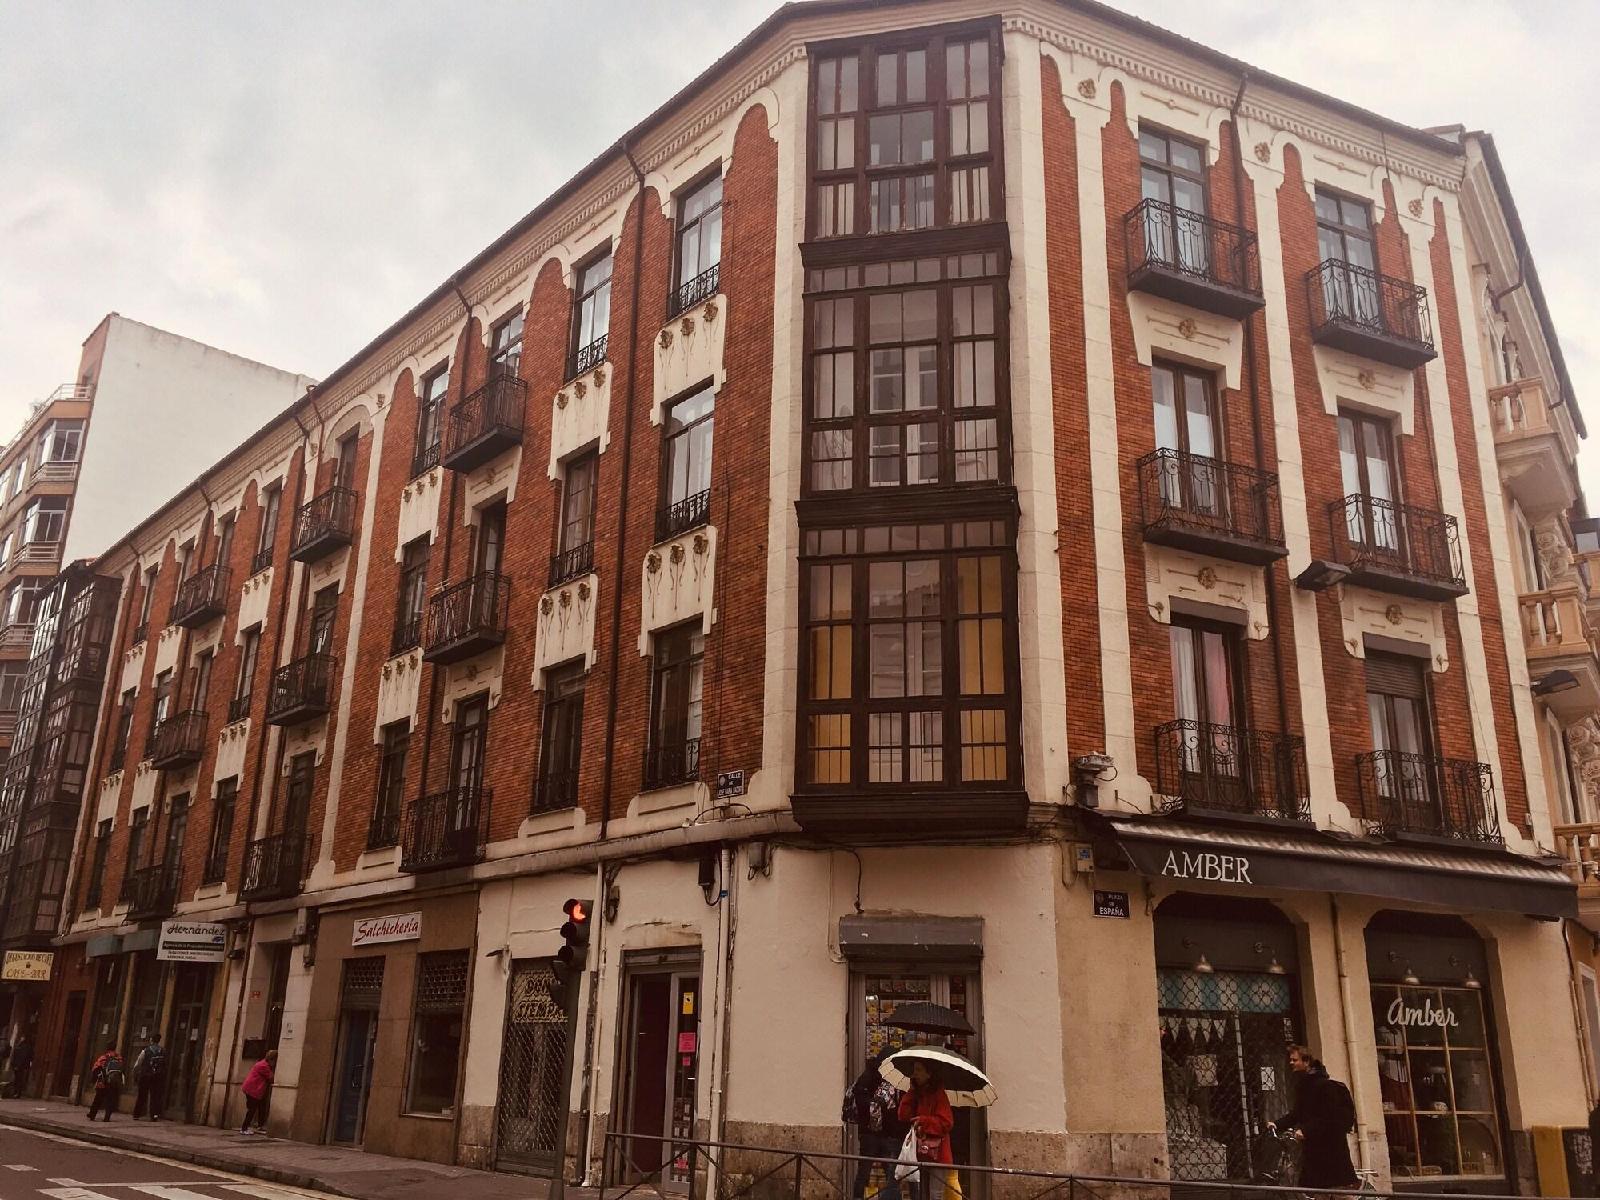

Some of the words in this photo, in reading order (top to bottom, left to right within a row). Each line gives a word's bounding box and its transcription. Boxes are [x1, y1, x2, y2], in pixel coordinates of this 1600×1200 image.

[1161, 849, 1253, 884] AMBER
[1099, 906, 1124, 916] ESPAÑA
[1387, 997, 1459, 1027] Amber
